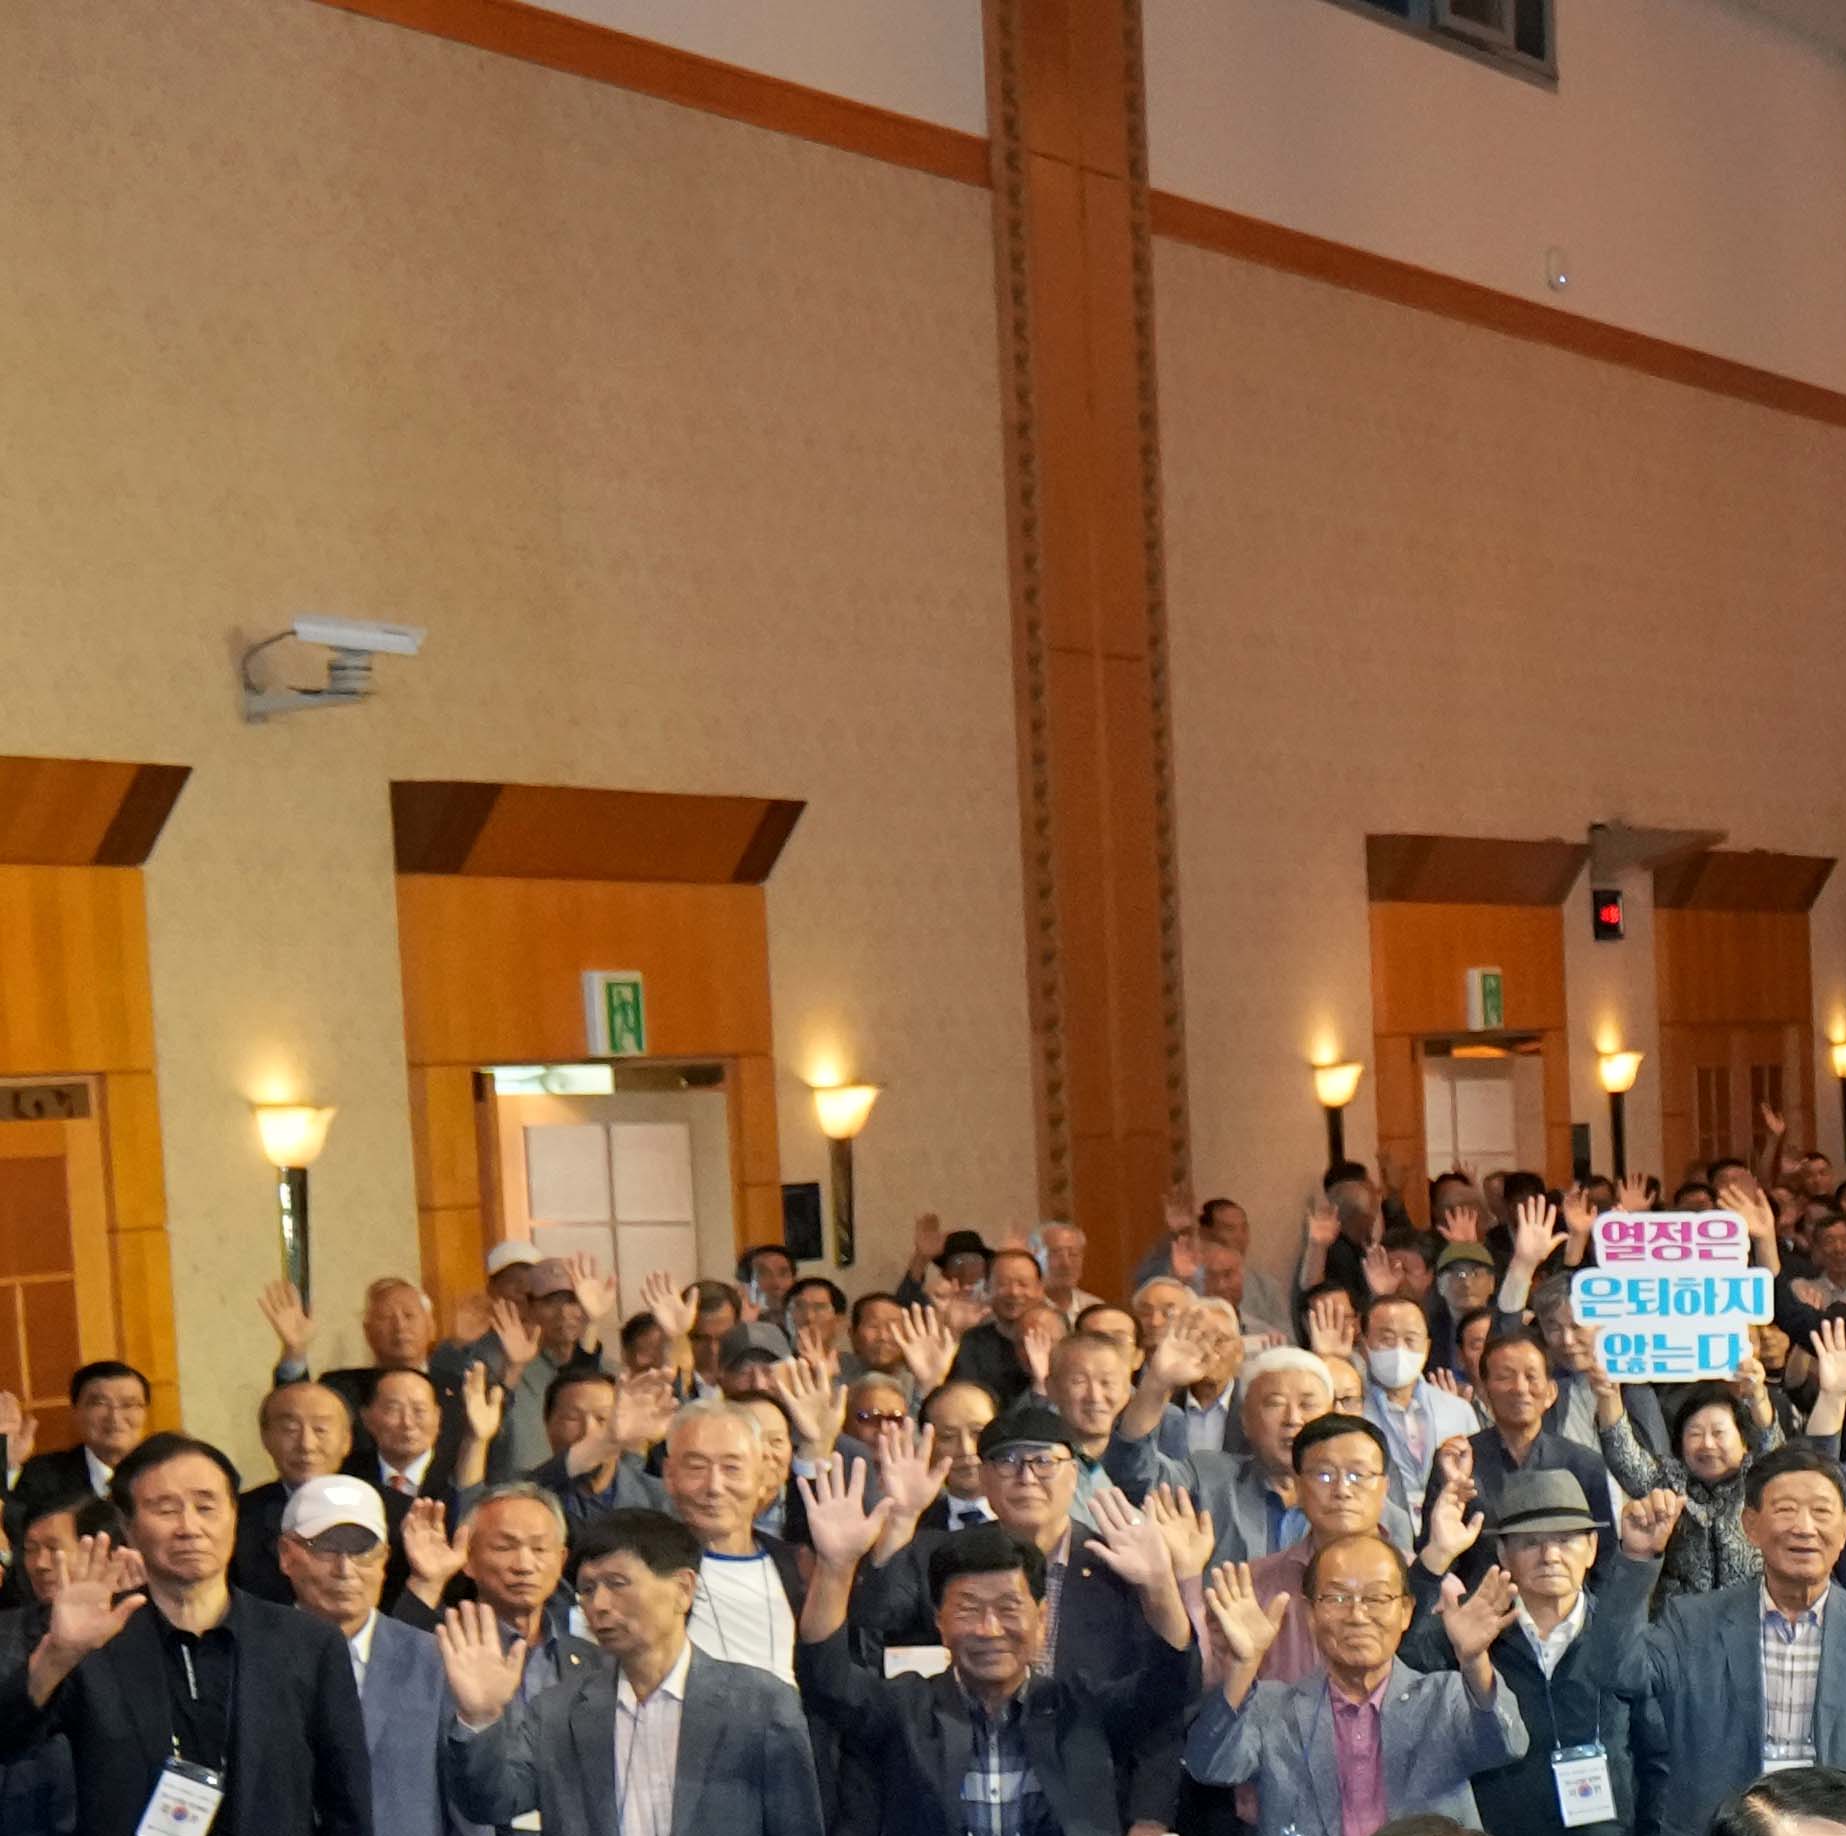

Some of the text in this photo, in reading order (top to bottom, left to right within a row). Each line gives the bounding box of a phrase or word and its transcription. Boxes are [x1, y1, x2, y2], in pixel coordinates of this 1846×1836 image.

[1601, 1220, 1741, 1264] 열정은
[1579, 1276, 1767, 1320] 은퇴하지
[1602, 1330, 1746, 1378] 않는다
